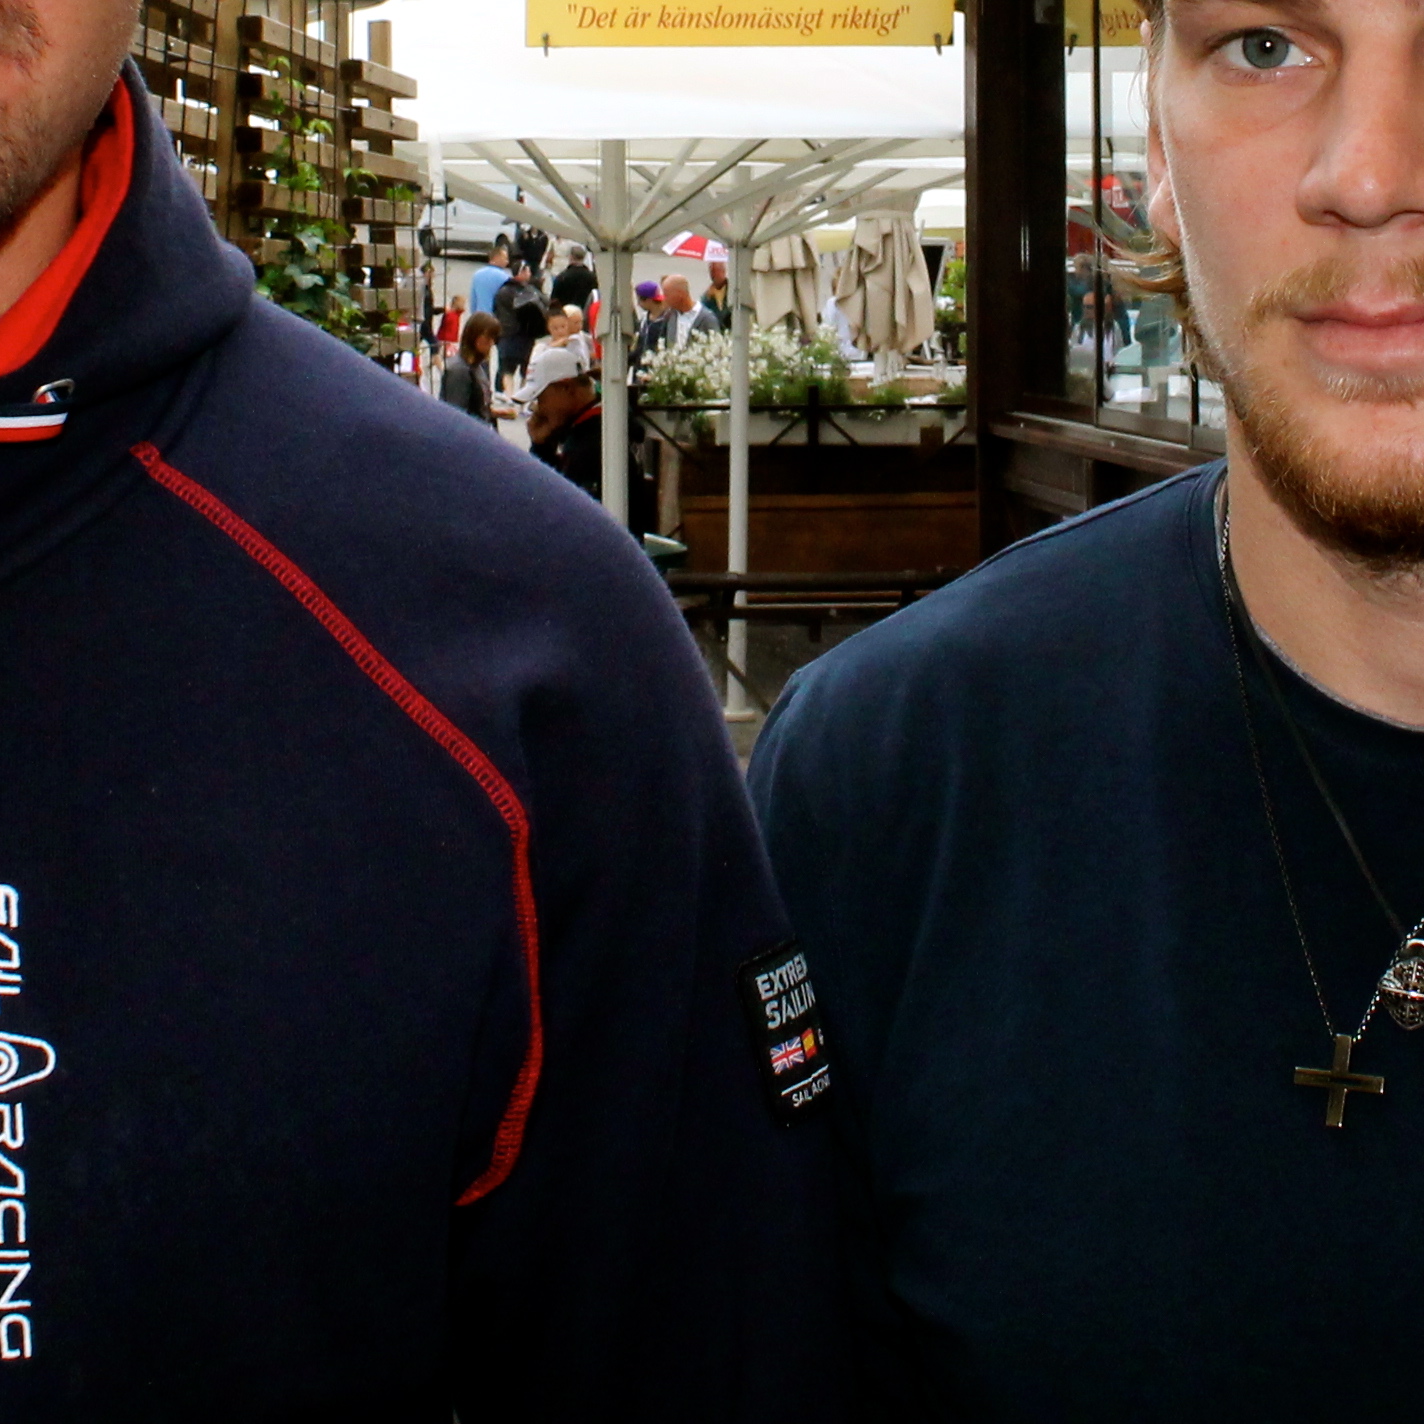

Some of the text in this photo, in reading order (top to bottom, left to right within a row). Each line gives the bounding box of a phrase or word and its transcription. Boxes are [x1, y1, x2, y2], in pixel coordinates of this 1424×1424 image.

[624, 7, 651, 29] är
[657, 5, 824, 36] känslomässigt
[755, 953, 808, 1001] EXTRE
